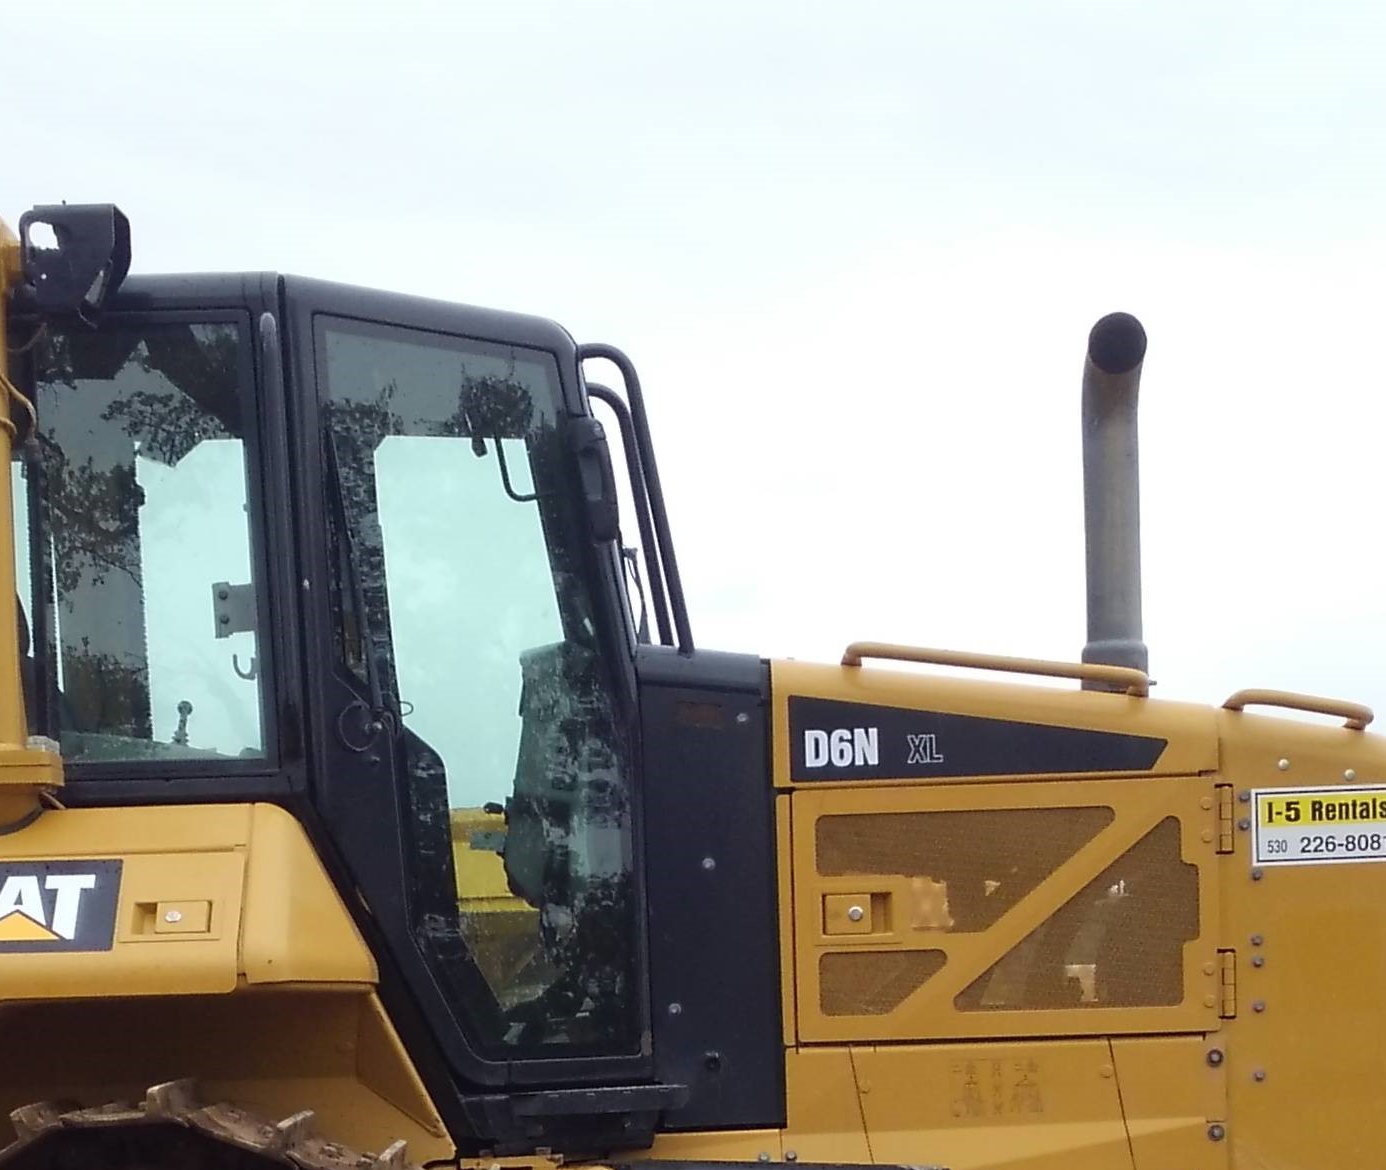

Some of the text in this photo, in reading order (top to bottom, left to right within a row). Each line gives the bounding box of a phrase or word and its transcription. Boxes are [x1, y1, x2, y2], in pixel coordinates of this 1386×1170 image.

[805, 728, 944, 768] D6N XL
[1267, 801, 1301, 823] I-5
[1267, 839, 1288, 853] 530
